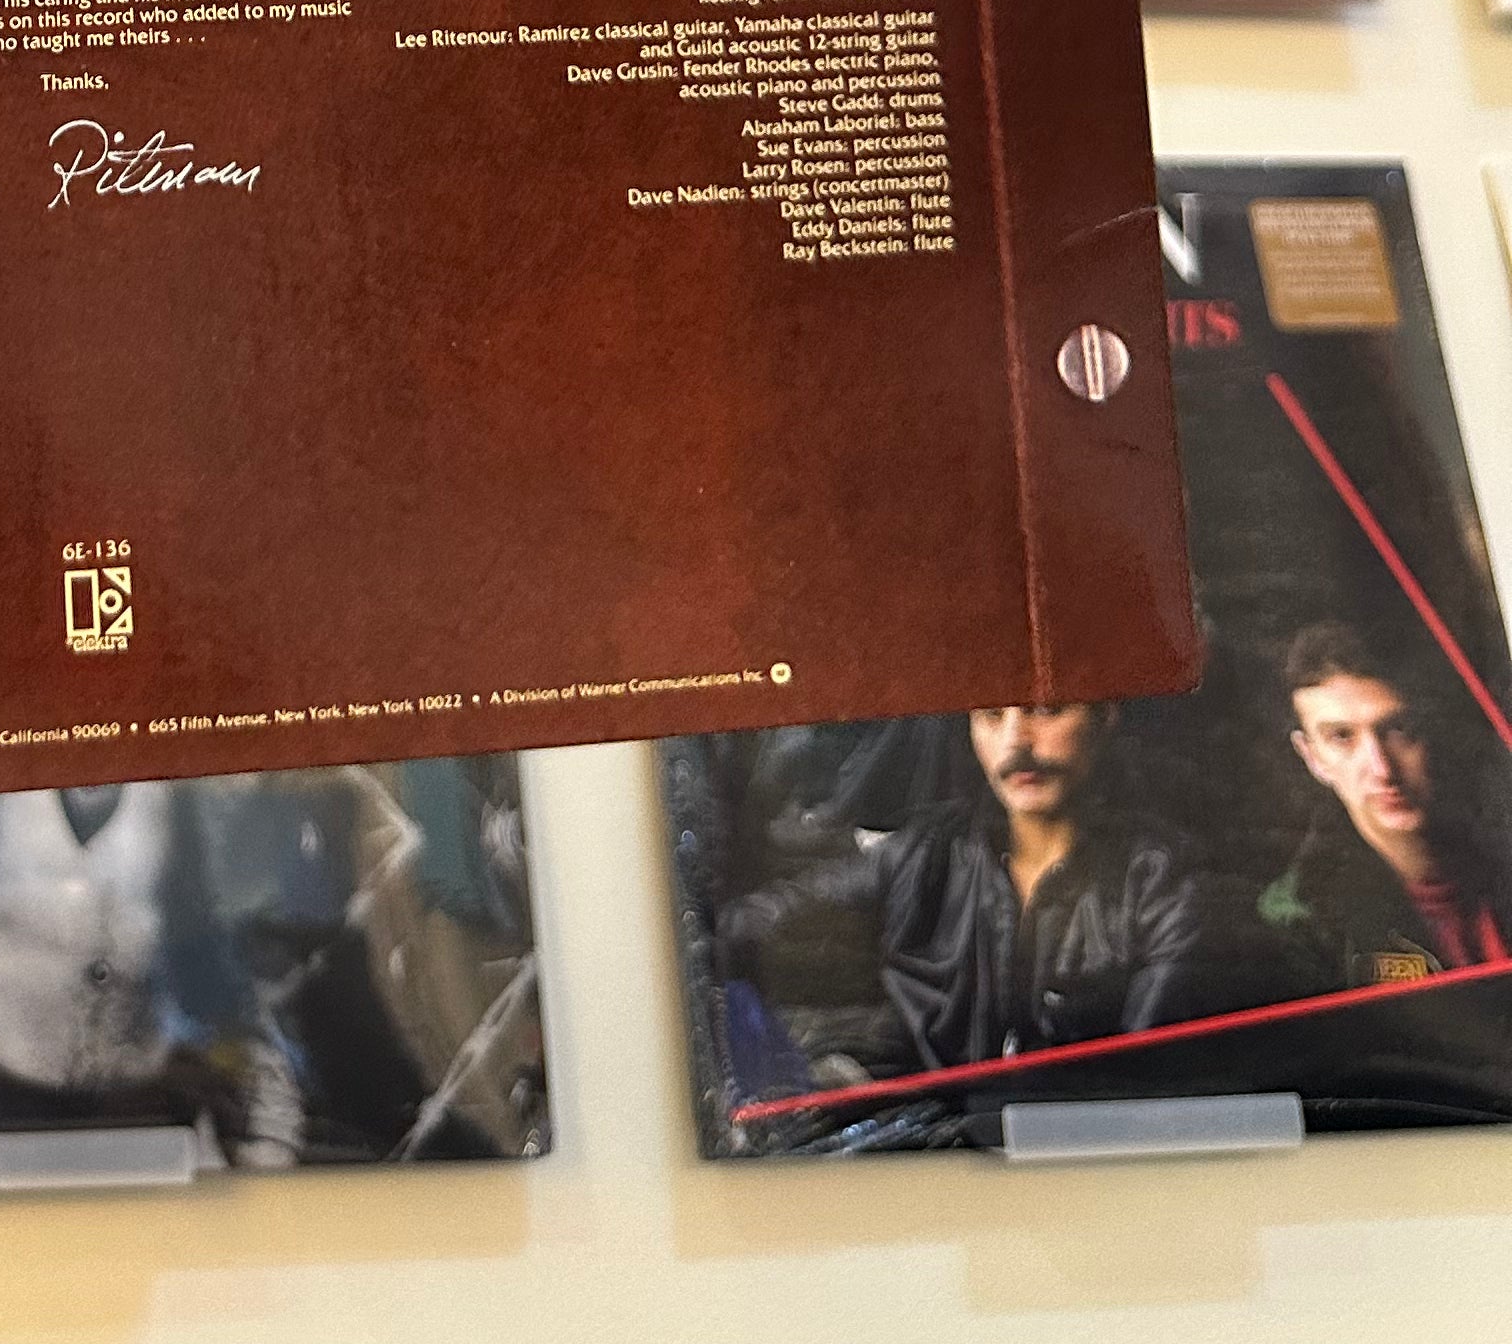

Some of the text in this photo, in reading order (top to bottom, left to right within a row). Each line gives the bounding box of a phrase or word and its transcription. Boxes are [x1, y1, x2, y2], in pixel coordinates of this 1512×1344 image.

[39, 71, 109, 92] Thanks,
[782, 233, 955, 262] Ray Beckstein: flute
[62, 538, 132, 561] 6E-136
[148, 693, 463, 734] 665 Fifth Avenue, New York, New York 10022
[71, 721, 121, 740] 90069
